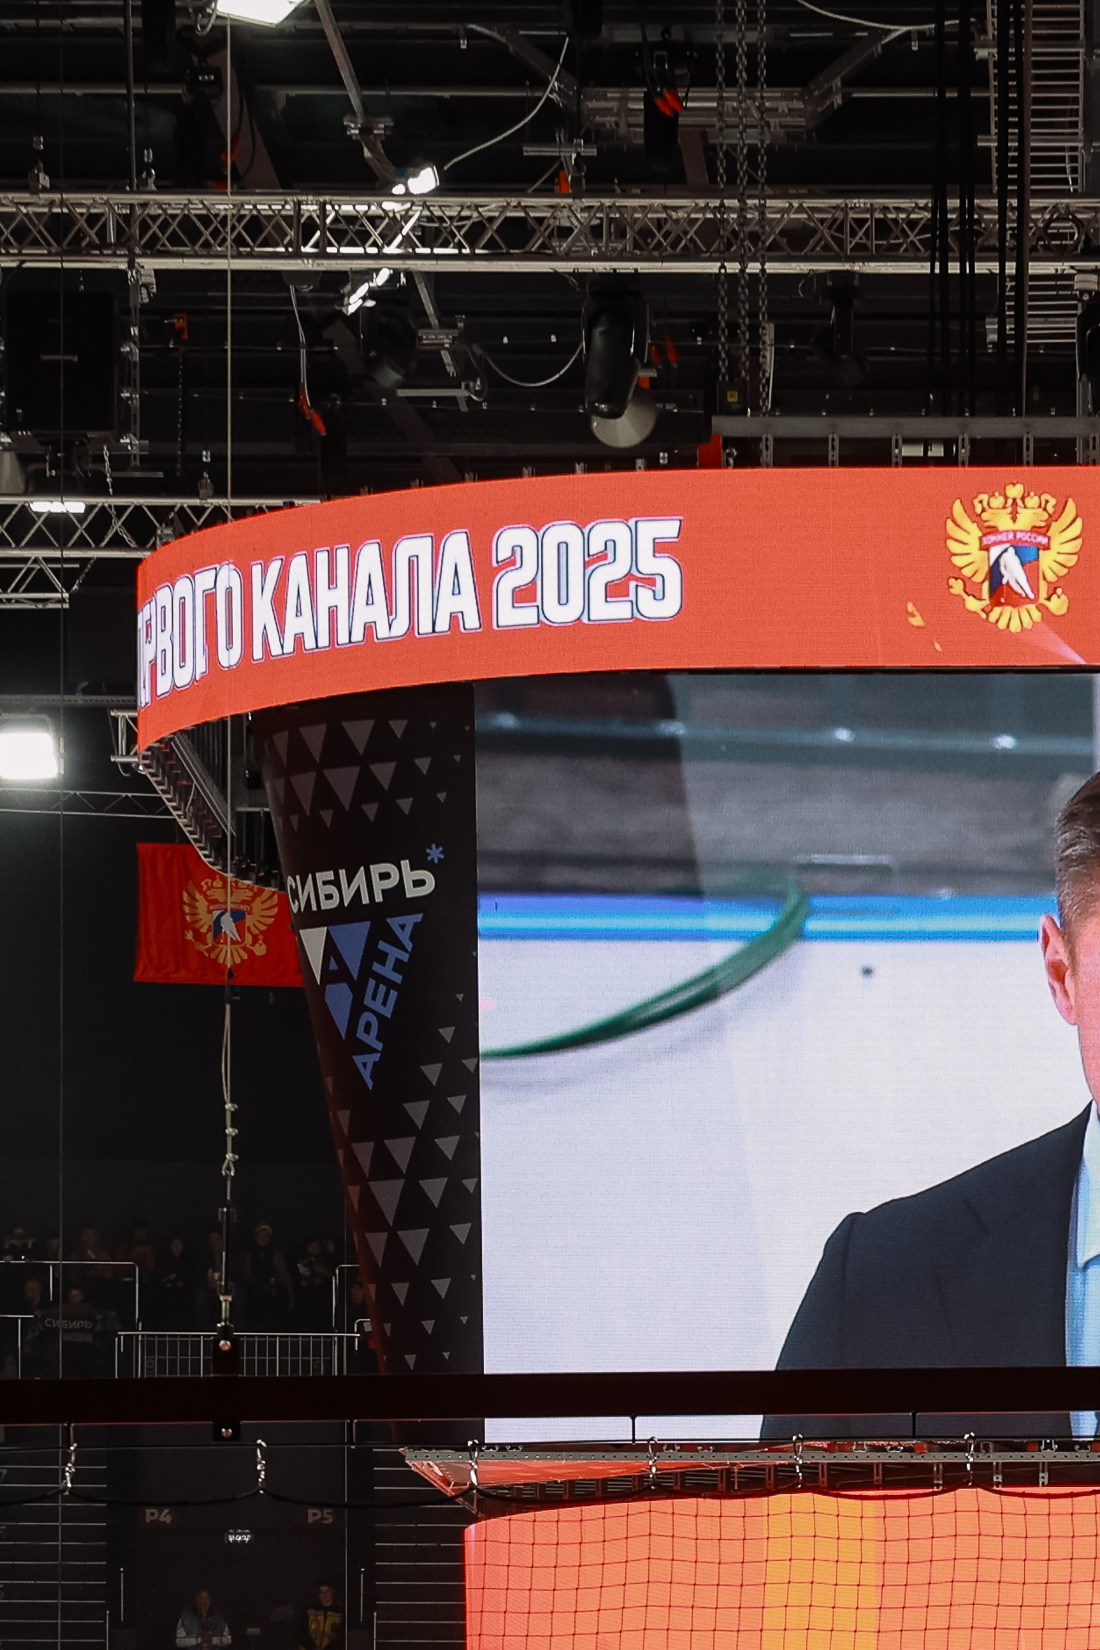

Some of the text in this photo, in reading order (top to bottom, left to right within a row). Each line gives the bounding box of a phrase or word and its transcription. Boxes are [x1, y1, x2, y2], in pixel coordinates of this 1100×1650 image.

[251, 528, 480, 660] КАНАЛА
[492, 516, 683, 631] 2025
[287, 859, 435, 914] СИБИРЬ
[352, 912, 424, 1091] АРЕНА
